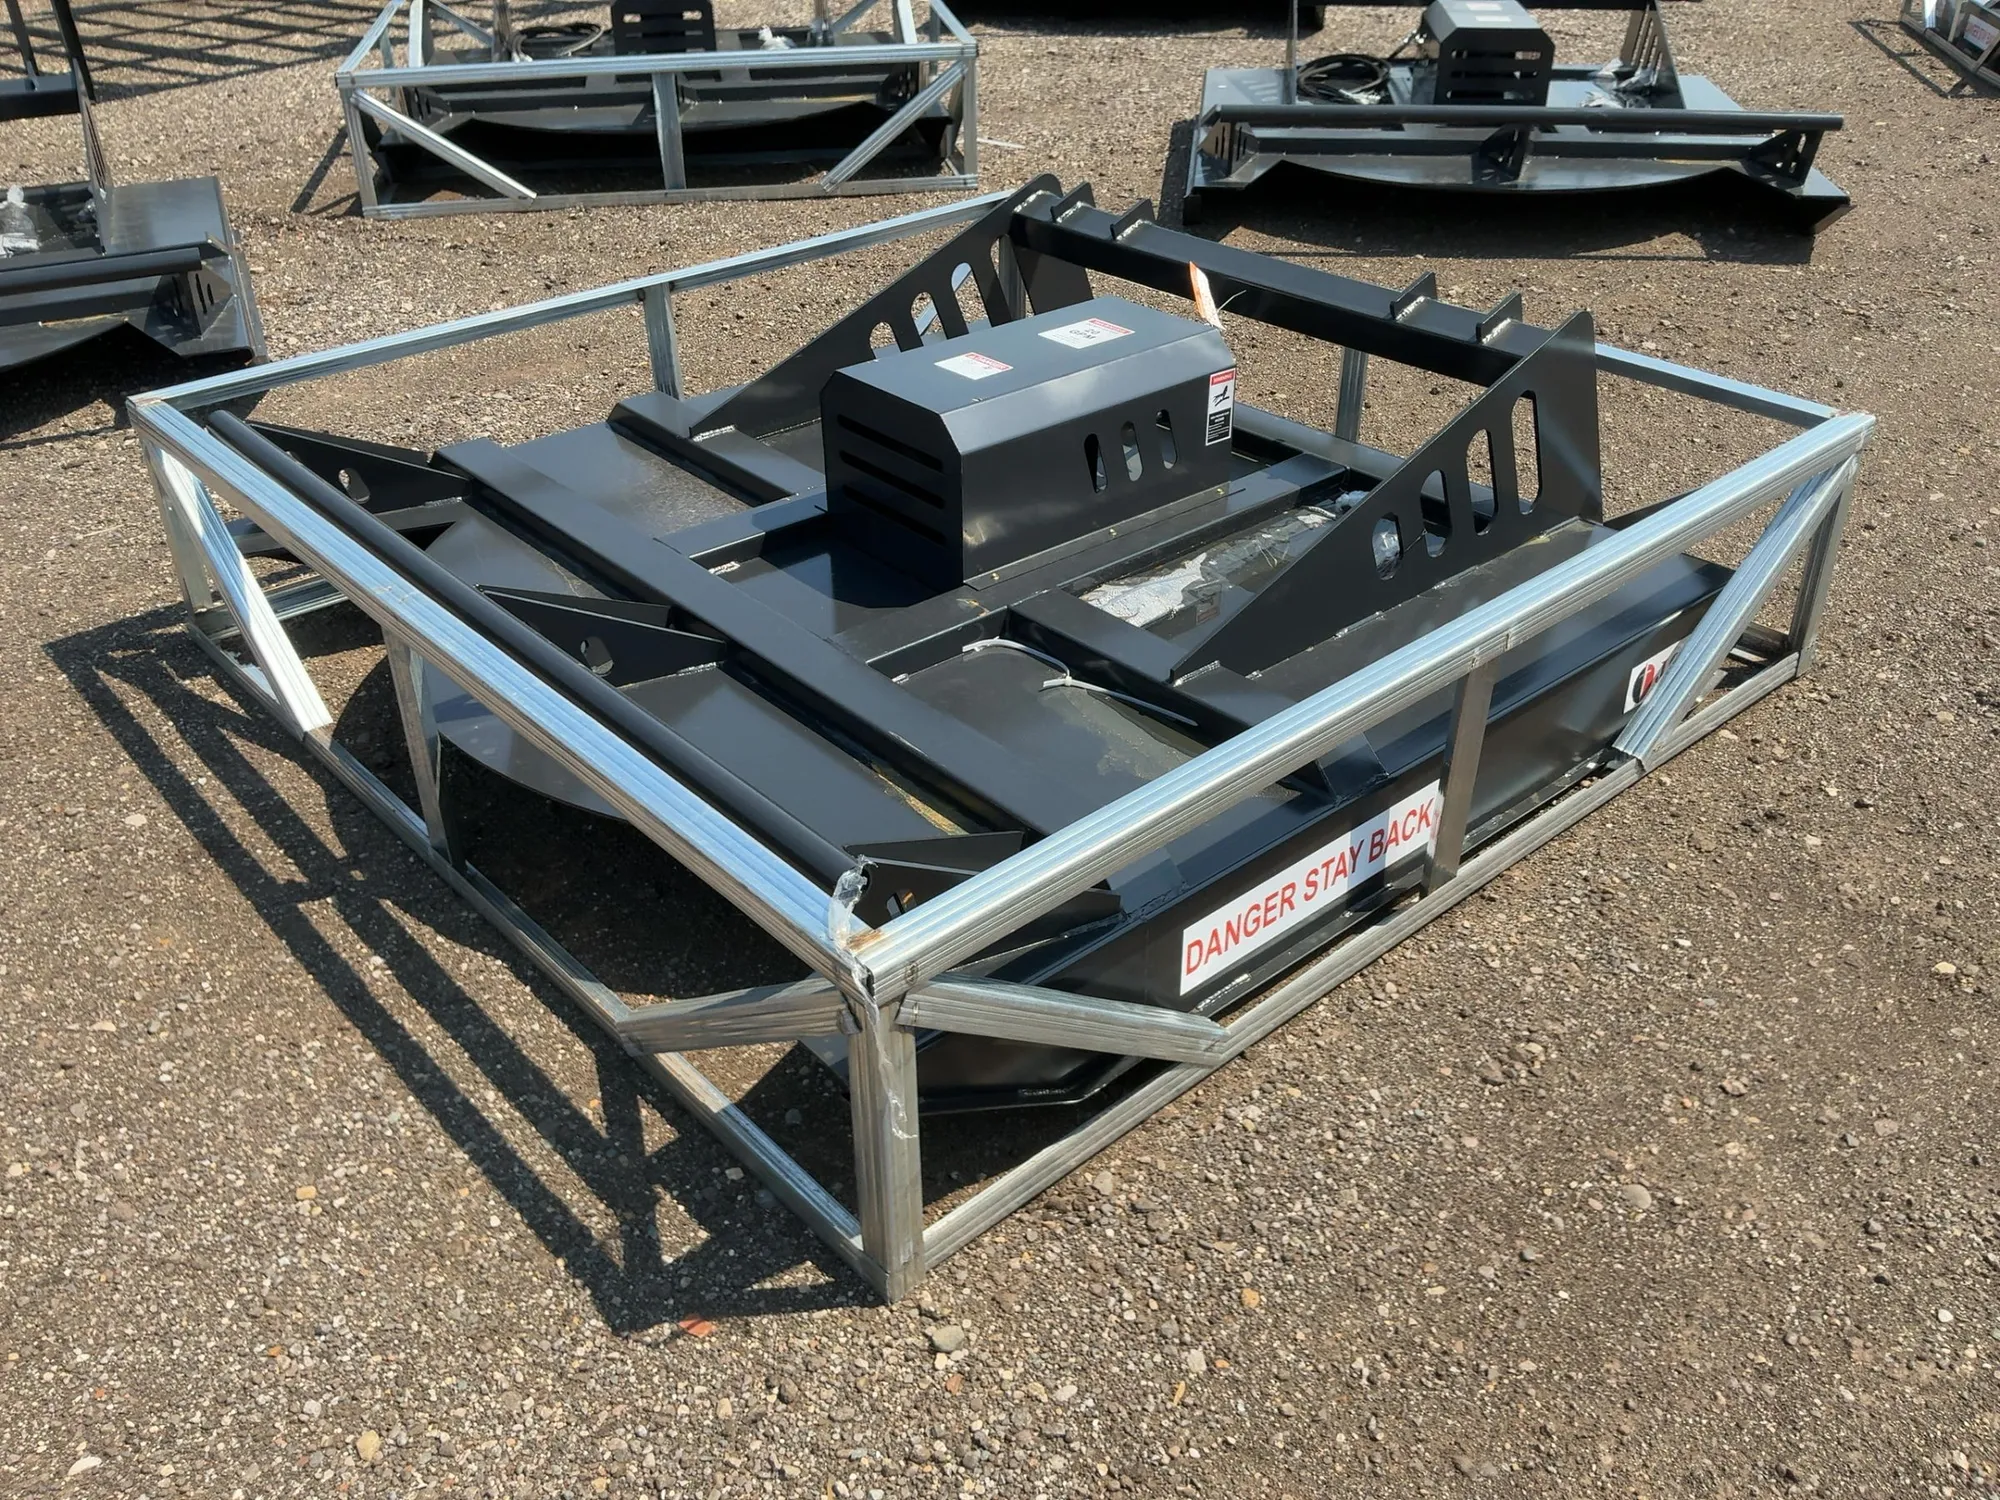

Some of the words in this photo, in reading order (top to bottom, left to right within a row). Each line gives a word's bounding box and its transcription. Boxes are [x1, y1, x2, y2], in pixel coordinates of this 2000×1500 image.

[1185, 881, 1297, 976] DANGER
[1303, 839, 1365, 902] STAY
[1368, 797, 1434, 864] BACK
